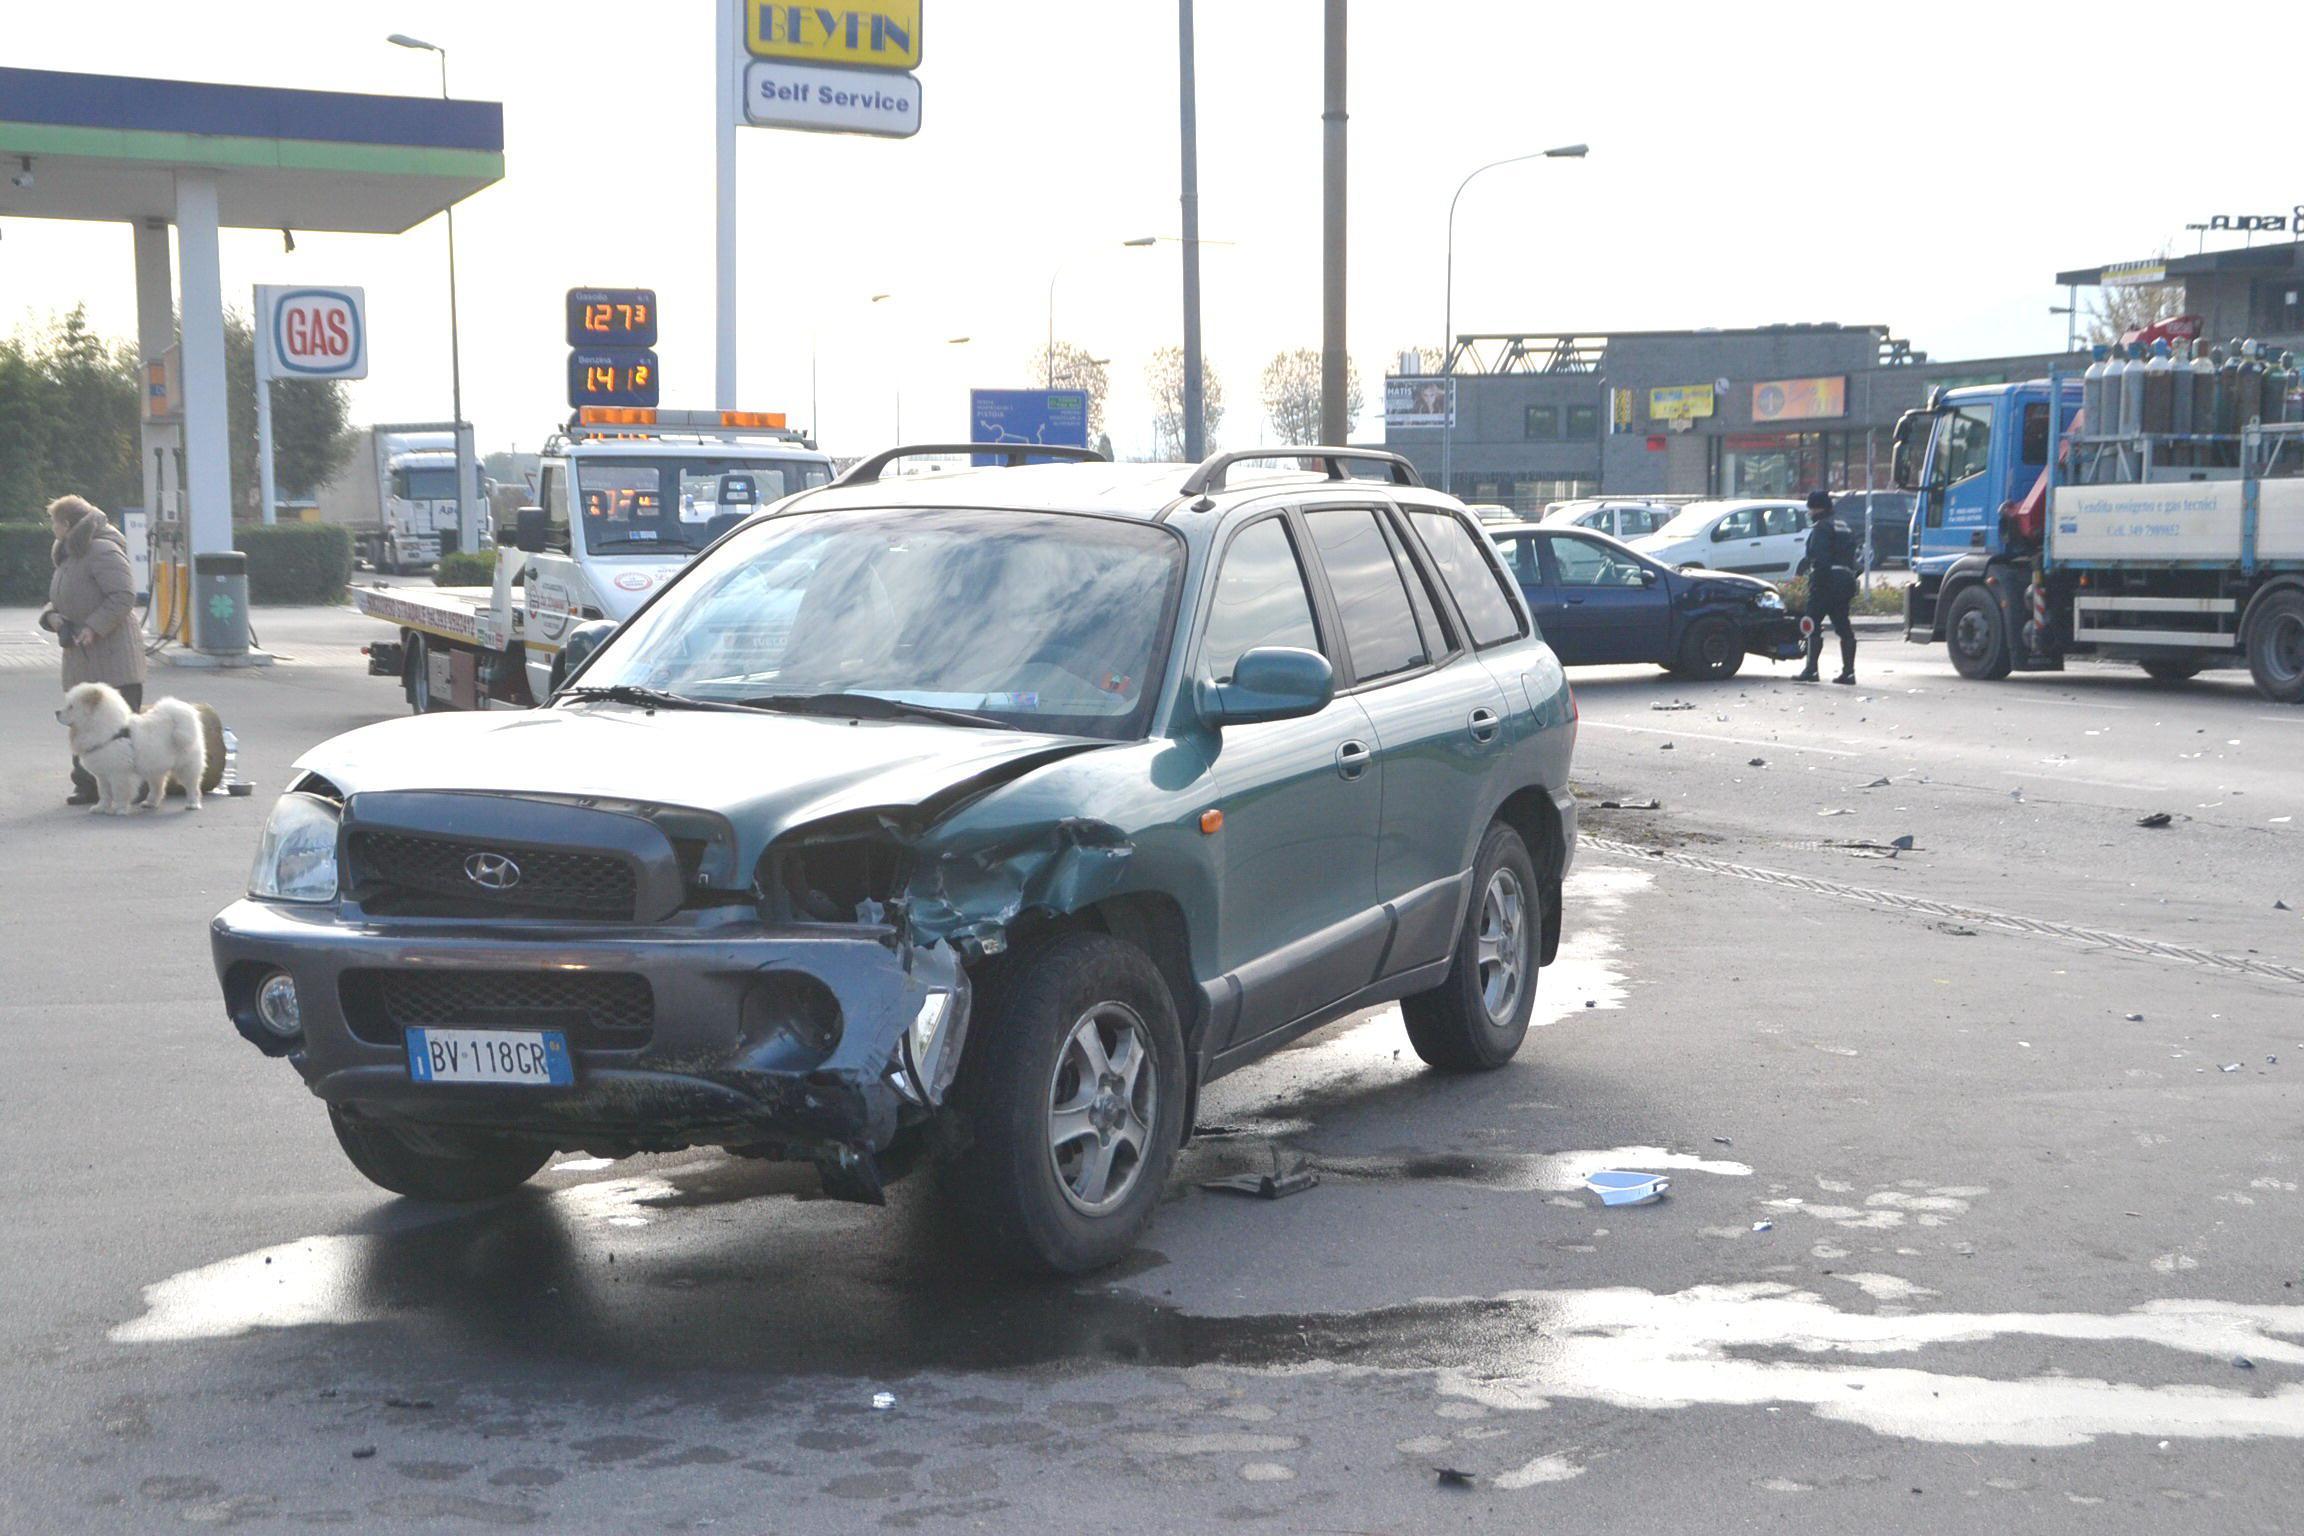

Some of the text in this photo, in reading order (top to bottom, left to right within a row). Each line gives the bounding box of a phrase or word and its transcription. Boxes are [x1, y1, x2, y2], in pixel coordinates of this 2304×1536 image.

[759, 4, 910, 54] BEYFIN
[761, 80, 910, 112] Self Service
[287, 307, 349, 356] GAS
[430, 1041, 458, 1072] BV
